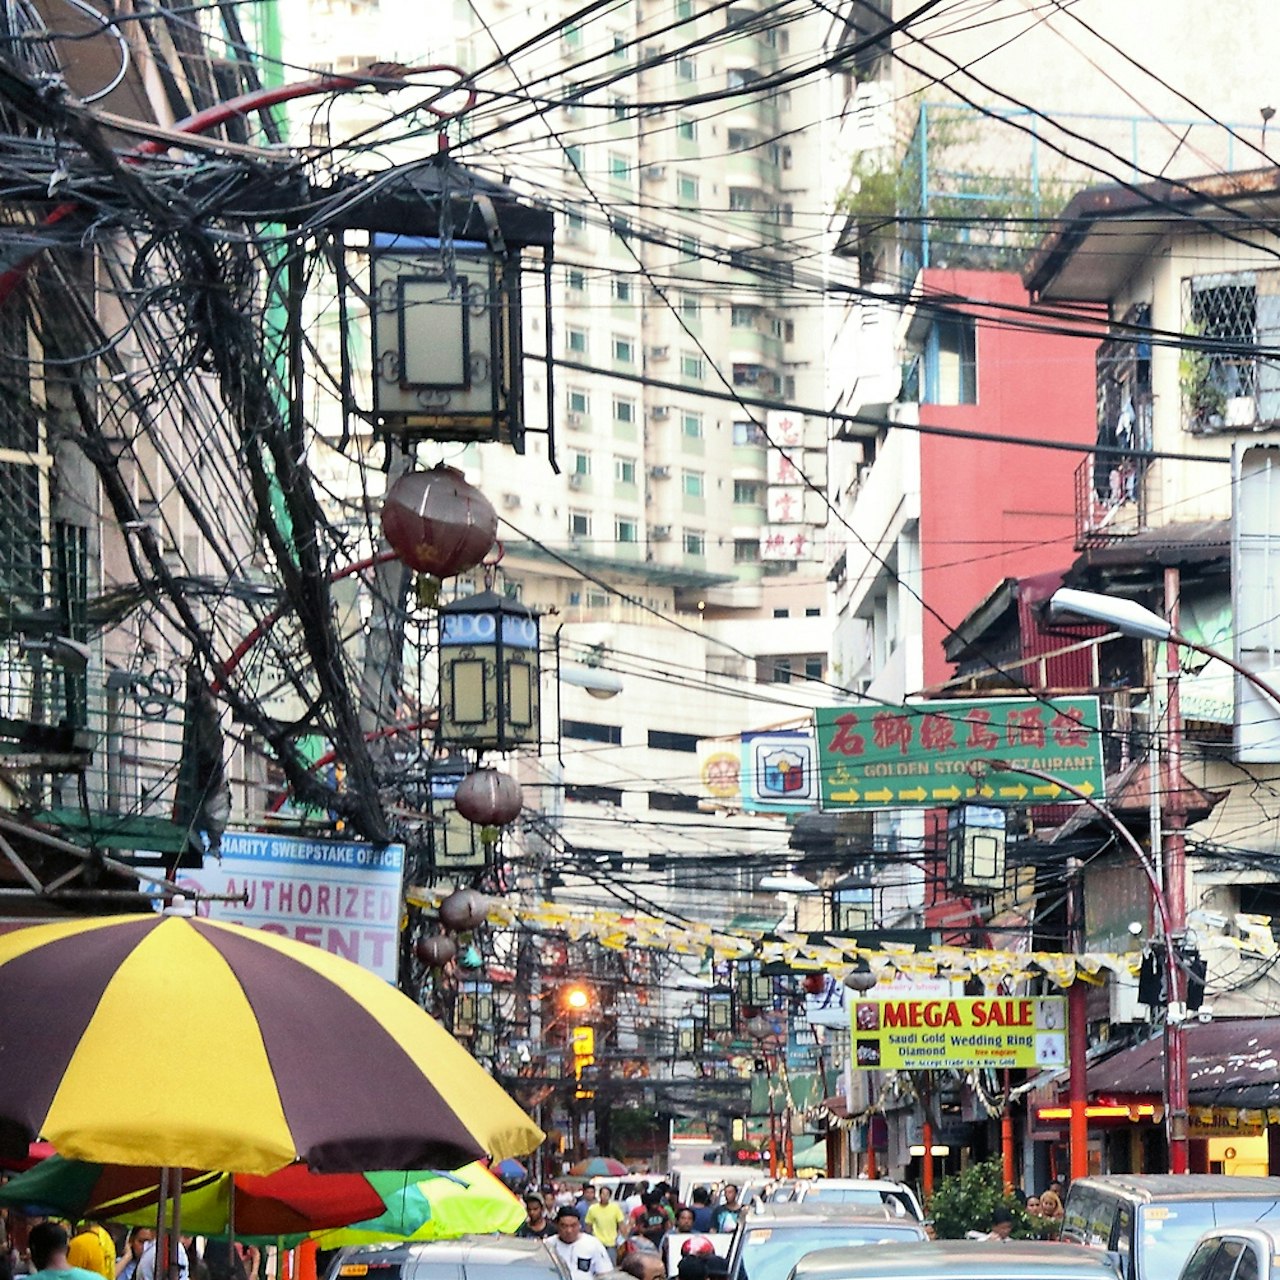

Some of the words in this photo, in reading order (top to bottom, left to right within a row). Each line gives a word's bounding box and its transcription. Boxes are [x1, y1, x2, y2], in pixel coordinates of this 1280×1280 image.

[864, 761, 930, 778] GOLDEN
[221, 837, 268, 856] HARITY
[271, 843, 354, 863] SWEEPSTAKE
[224, 878, 393, 921] AUTHORIZED
[883, 1001, 962, 1028] MEGA
[971, 1001, 1033, 1027] SALE
[889, 1033, 918, 1044] Saudi
[922, 1033, 946, 1044] Gold
[951, 1034, 1001, 1048] Wedding
[1006, 1034, 1033, 1048] Ring
[898, 1046, 946, 1057] Diamond
